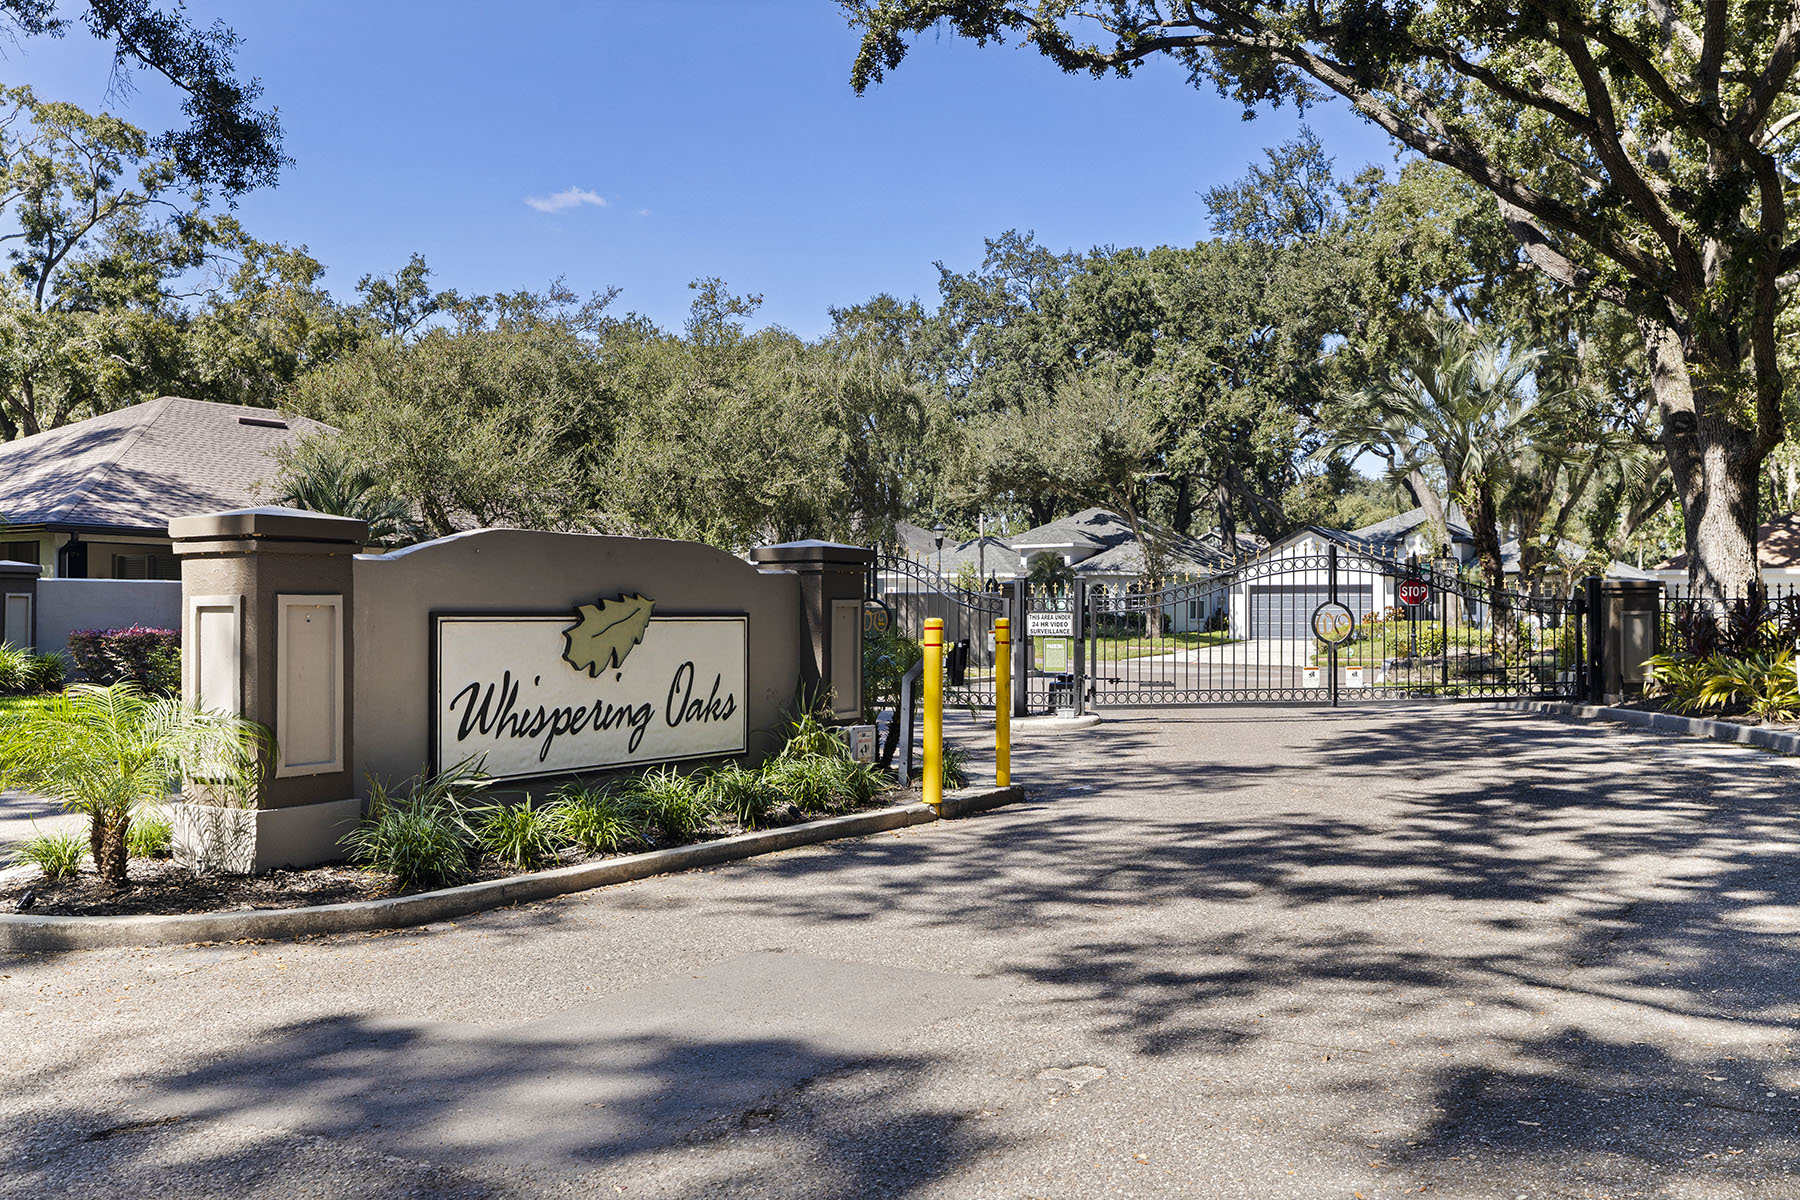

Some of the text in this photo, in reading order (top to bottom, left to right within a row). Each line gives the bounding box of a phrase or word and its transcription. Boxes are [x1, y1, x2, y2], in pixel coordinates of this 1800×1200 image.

[1401, 586, 1427, 597] STOP
[450, 661, 737, 762] Whispering Oaks
